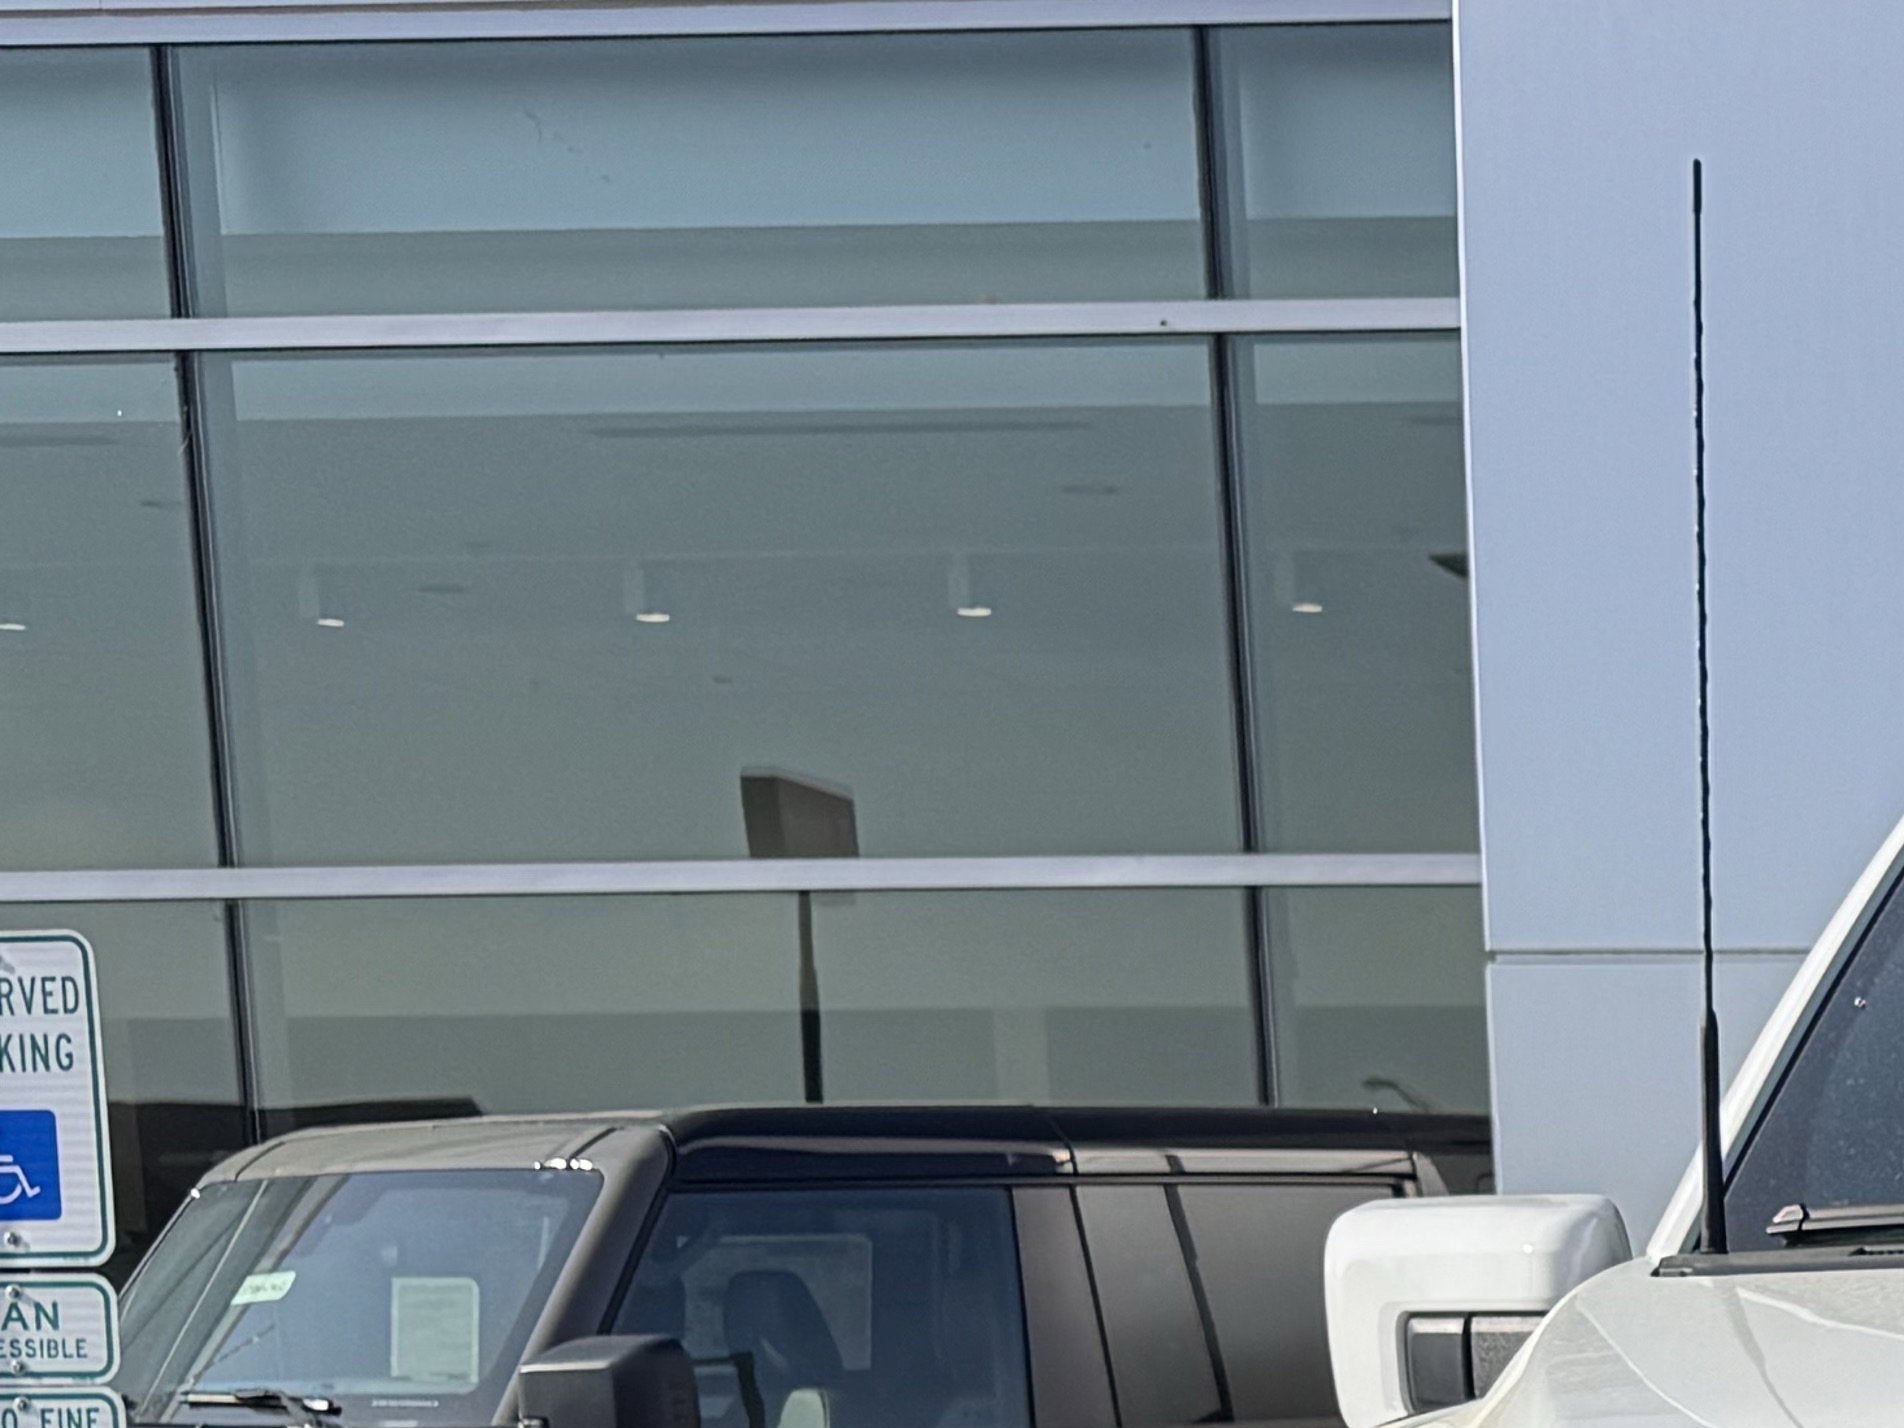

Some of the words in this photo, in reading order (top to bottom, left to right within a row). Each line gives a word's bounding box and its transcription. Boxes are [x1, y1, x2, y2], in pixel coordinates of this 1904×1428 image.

[0, 976, 79, 1016] RVED
[0, 1033, 73, 1073] KING
[1, 1301, 59, 1331] AN
